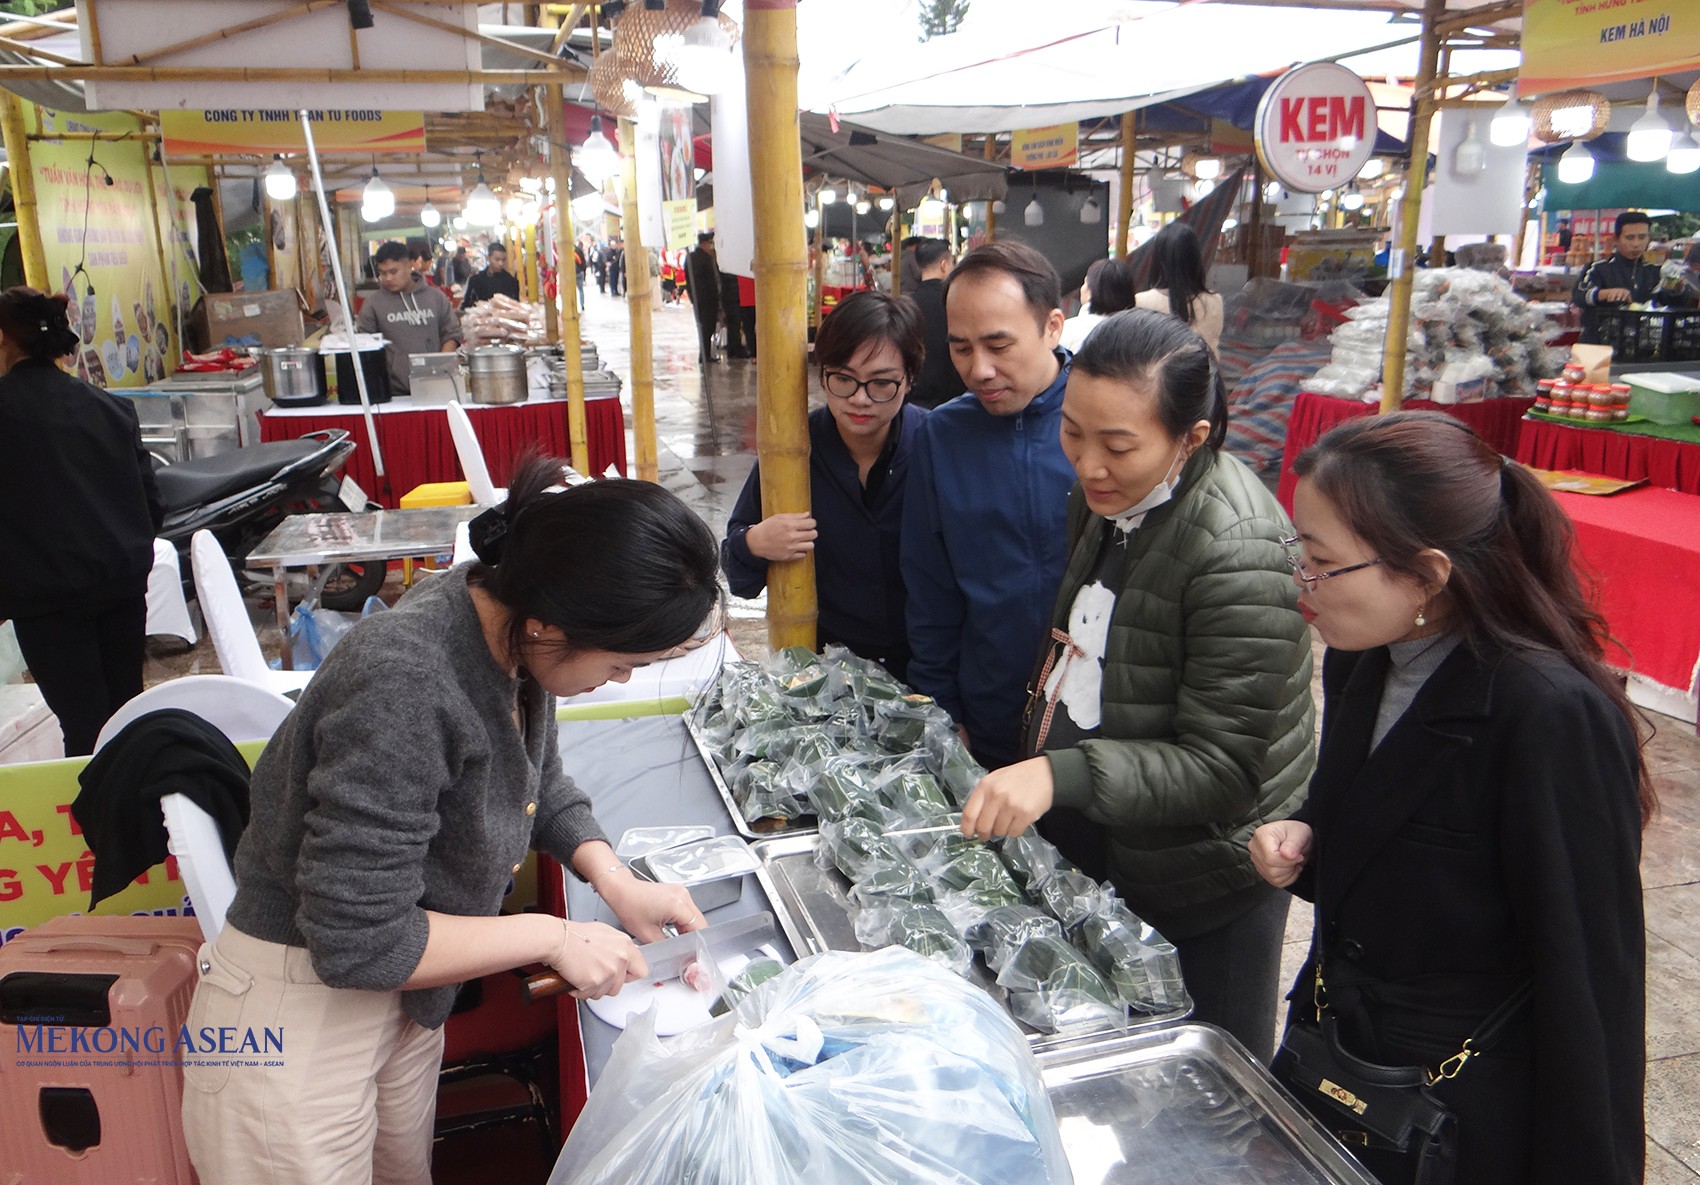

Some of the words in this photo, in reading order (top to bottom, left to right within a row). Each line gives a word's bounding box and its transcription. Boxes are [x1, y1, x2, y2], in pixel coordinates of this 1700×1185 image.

[1600, 24, 1626, 43] KEM
[1629, 17, 1645, 38] HÀ
[1648, 13, 1670, 36] NỘI
[240, 109, 254, 122] TY
[257, 109, 290, 122] TNHH
[344, 109, 383, 122] FOODS
[1279, 96, 1365, 143] KEM
[1307, 164, 1321, 176] 14
[1325, 164, 1337, 178] VỊ
